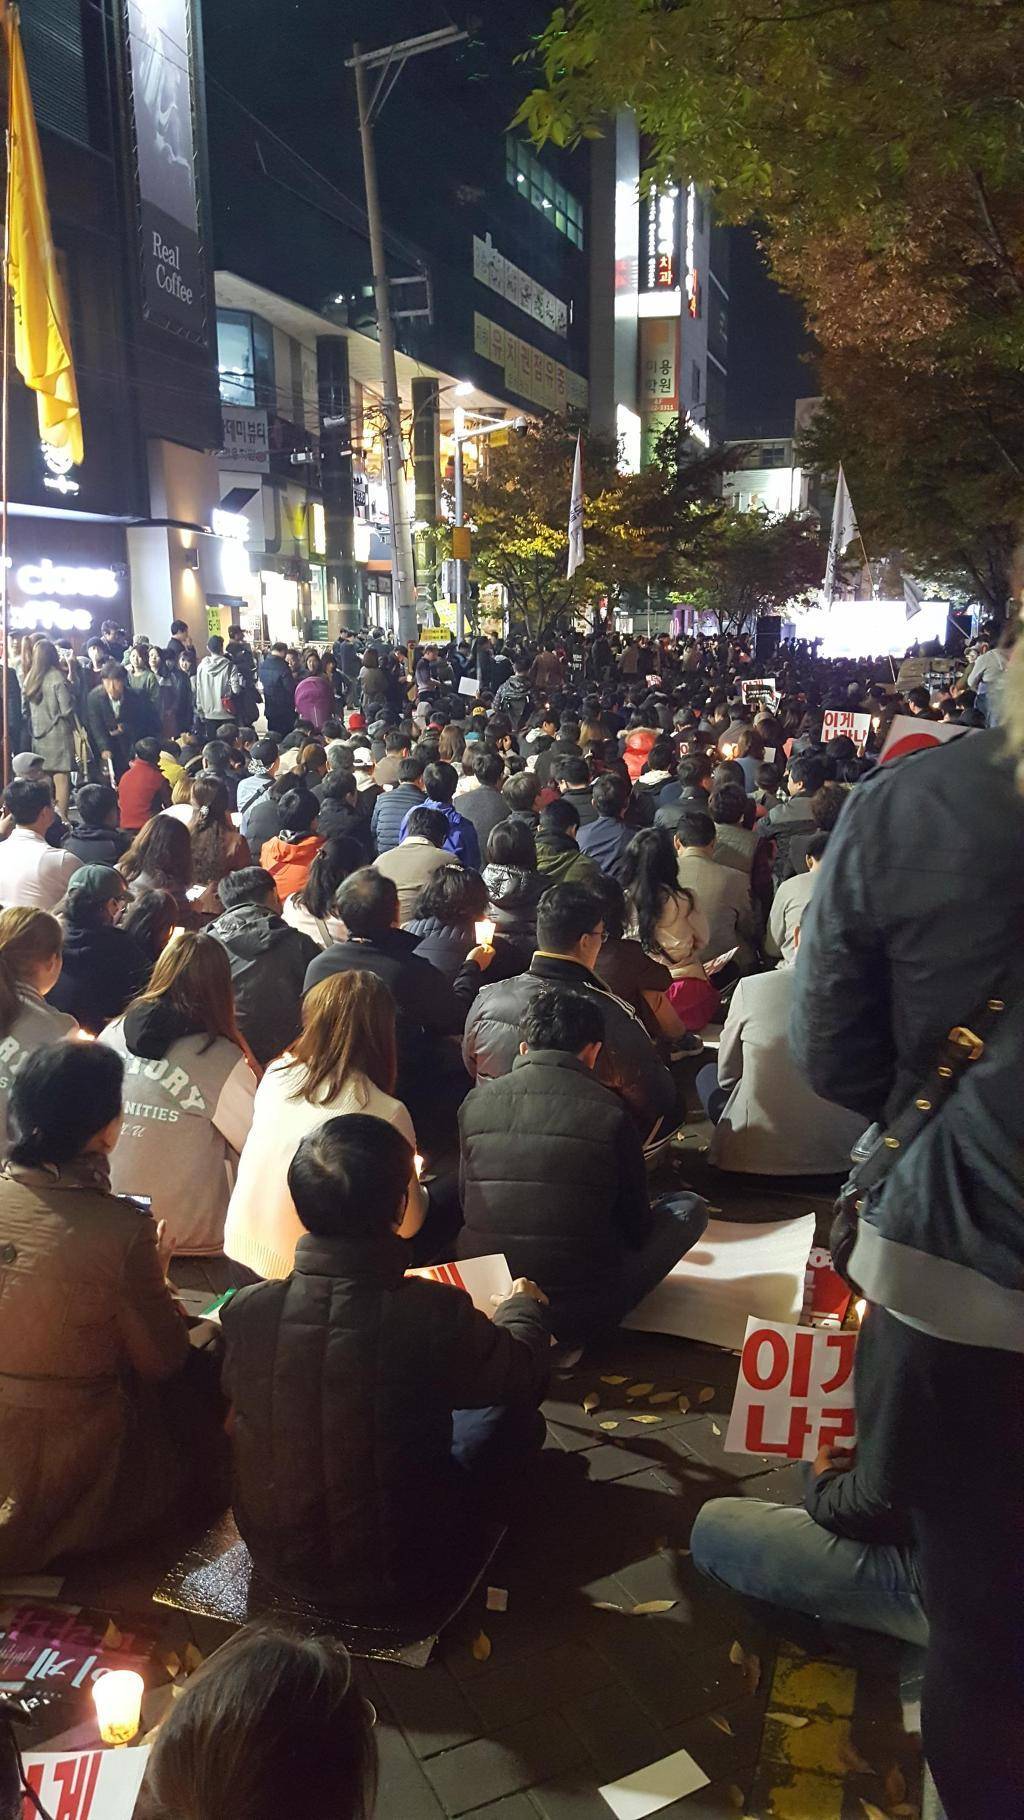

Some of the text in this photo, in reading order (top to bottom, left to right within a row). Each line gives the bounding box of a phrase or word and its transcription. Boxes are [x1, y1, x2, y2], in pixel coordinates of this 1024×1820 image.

[152, 231, 180, 270] Real
[156, 263, 193, 305] Coffee
[658, 256, 673, 286] 치과
[223, 419, 266, 445] 데미뷰티
[824, 711, 855, 728] 이게
